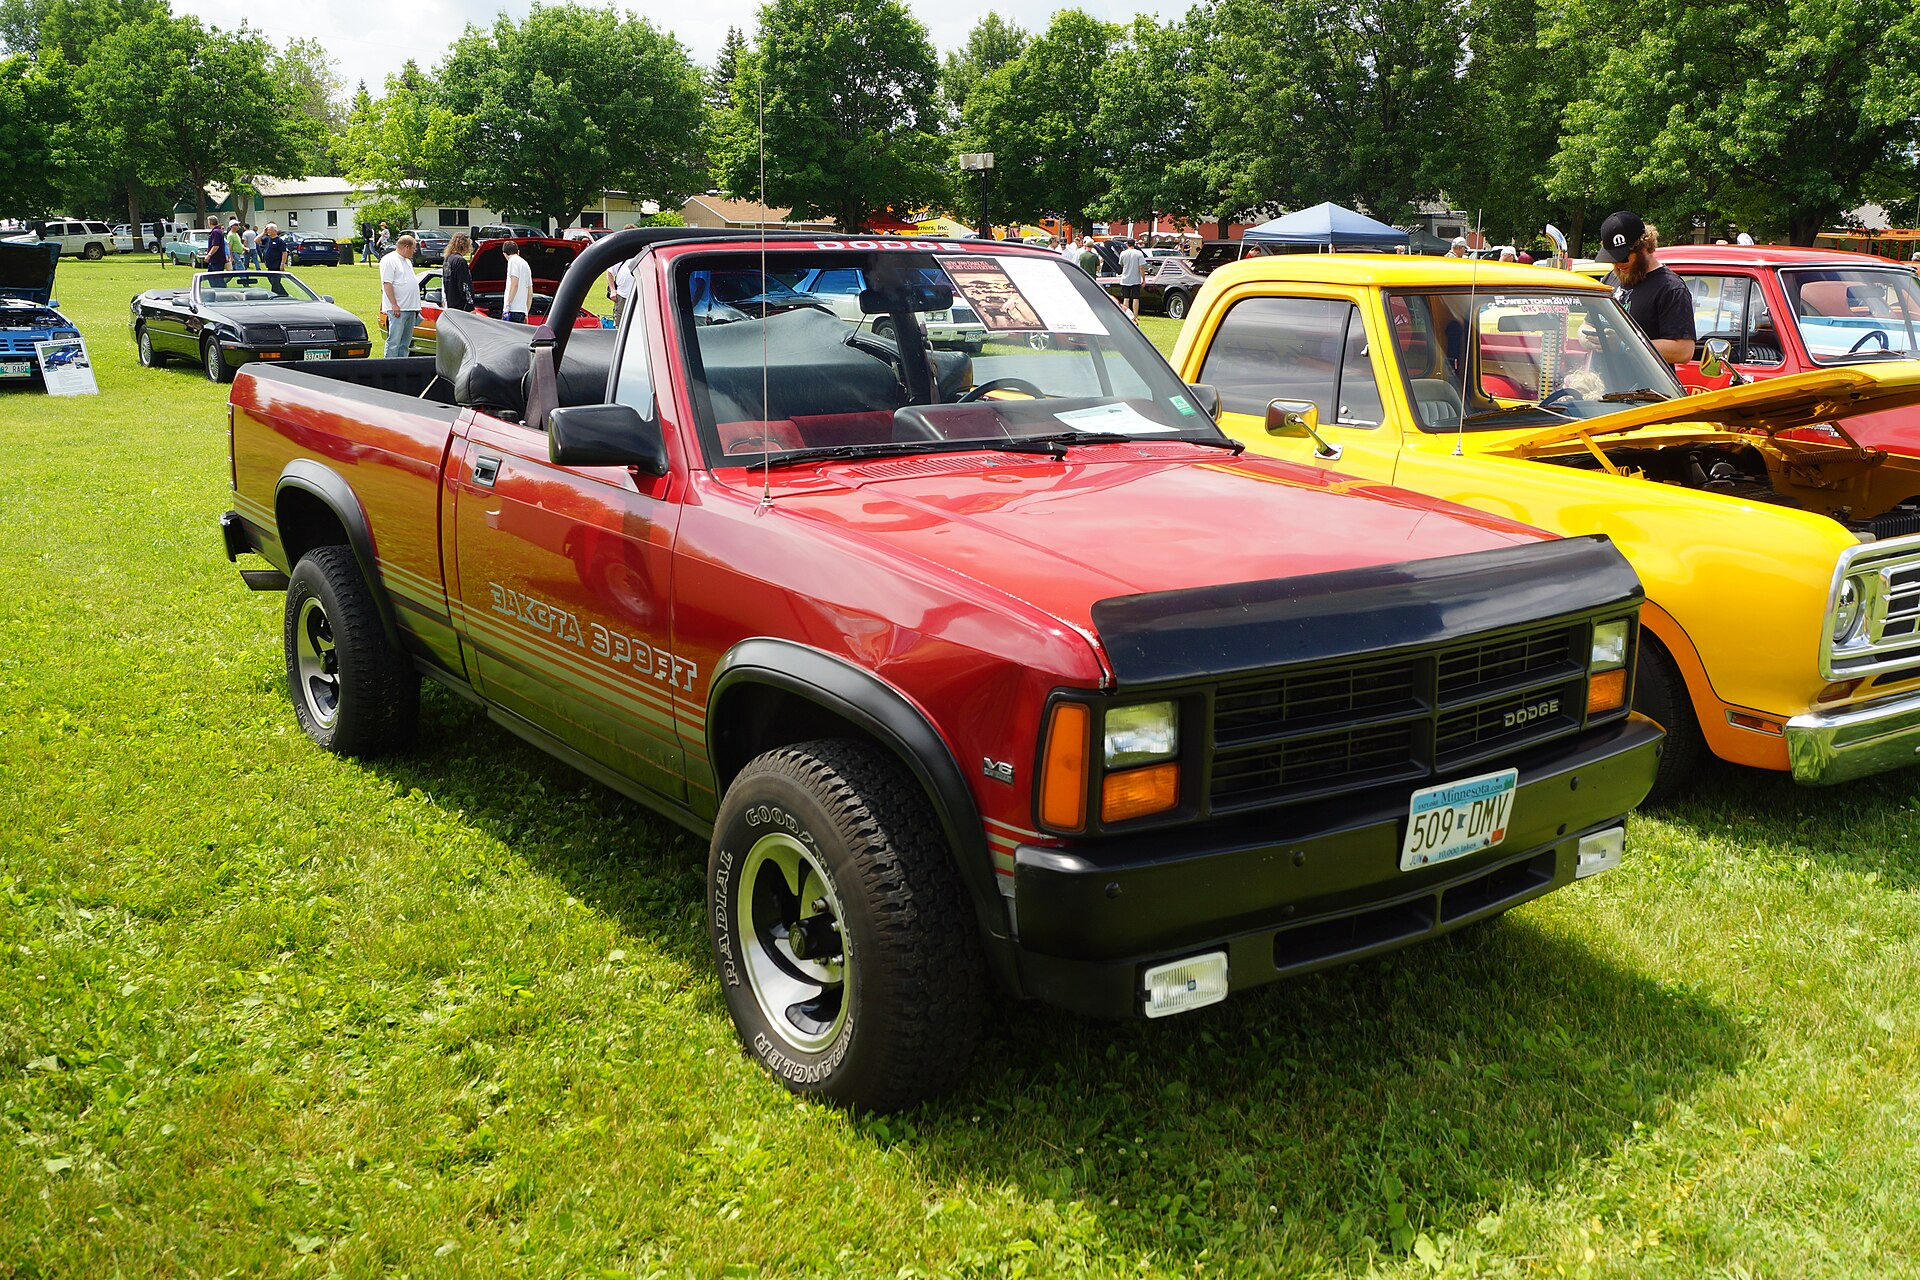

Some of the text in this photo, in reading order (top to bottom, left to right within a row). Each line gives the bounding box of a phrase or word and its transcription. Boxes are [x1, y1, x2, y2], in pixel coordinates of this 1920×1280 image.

[814, 240, 967, 251] DODGE
[1520, 305, 1537, 313] LONG
[1552, 296, 1570, 306] 2014
[489, 581, 698, 692] DAKOTA SPORT
[1503, 698, 1559, 728] DODGE
[984, 756, 1013, 775] V6
[1410, 792, 1510, 854] 509 DMV
[1438, 841, 1477, 858] 10,000 lakes
[715, 850, 740, 988] RADIAL
[753, 1017, 854, 1085] WRANGLER
